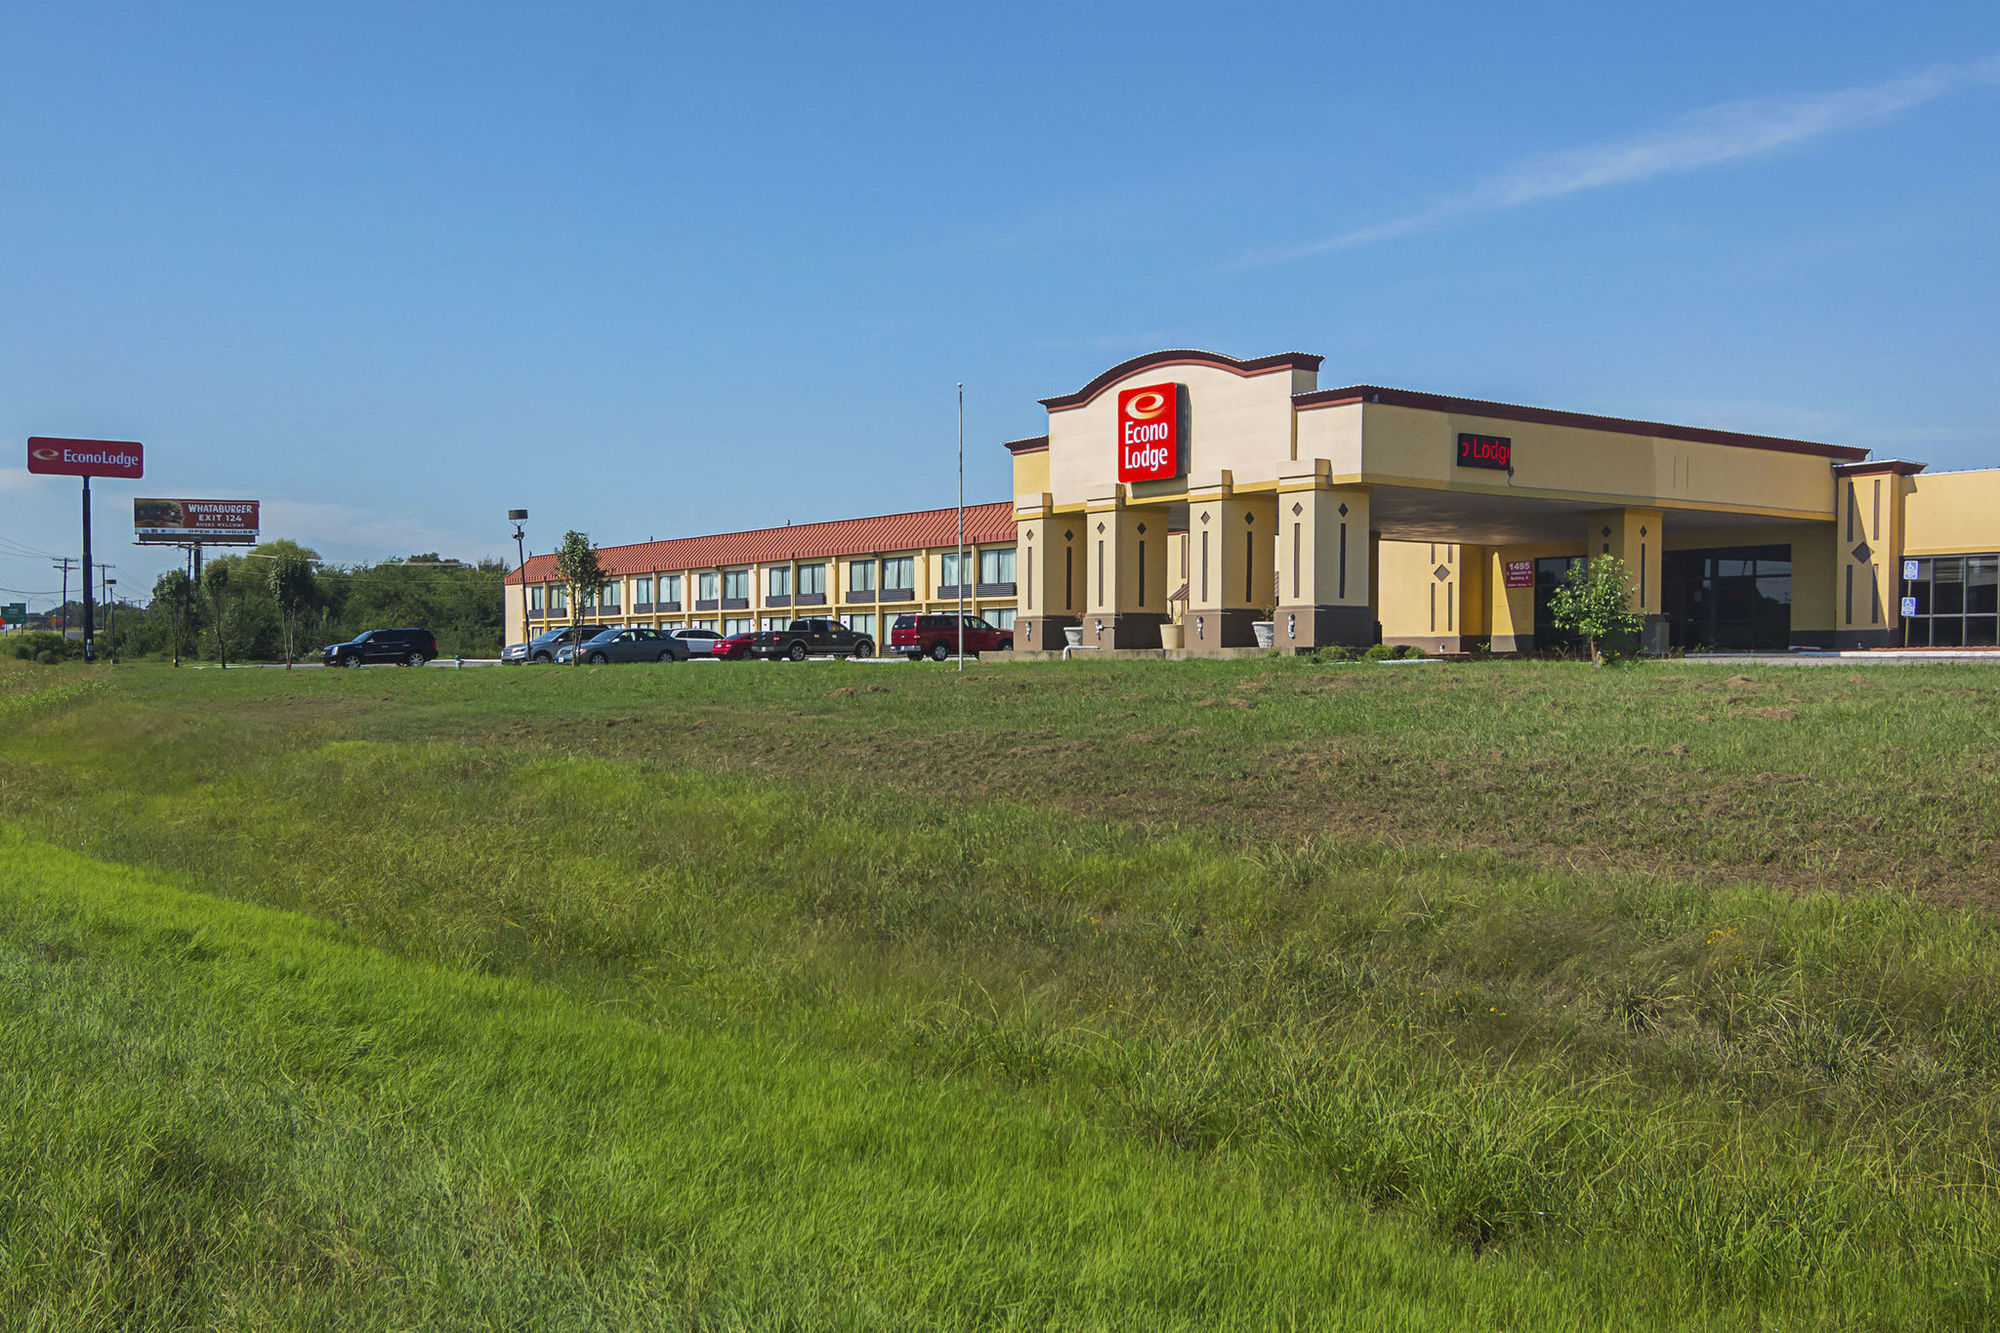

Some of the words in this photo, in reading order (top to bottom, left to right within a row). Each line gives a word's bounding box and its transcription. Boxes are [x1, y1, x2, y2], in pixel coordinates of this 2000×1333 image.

[1125, 421, 1168, 445] Econo
[63, 449, 139, 468] EconoLodge
[1125, 443, 1168, 472] Lodge
[188, 504, 252, 513] WHATABURGER
[198, 514, 222, 522] EXIT
[226, 514, 242, 522] 124
[1509, 562, 1530, 570] 1495
